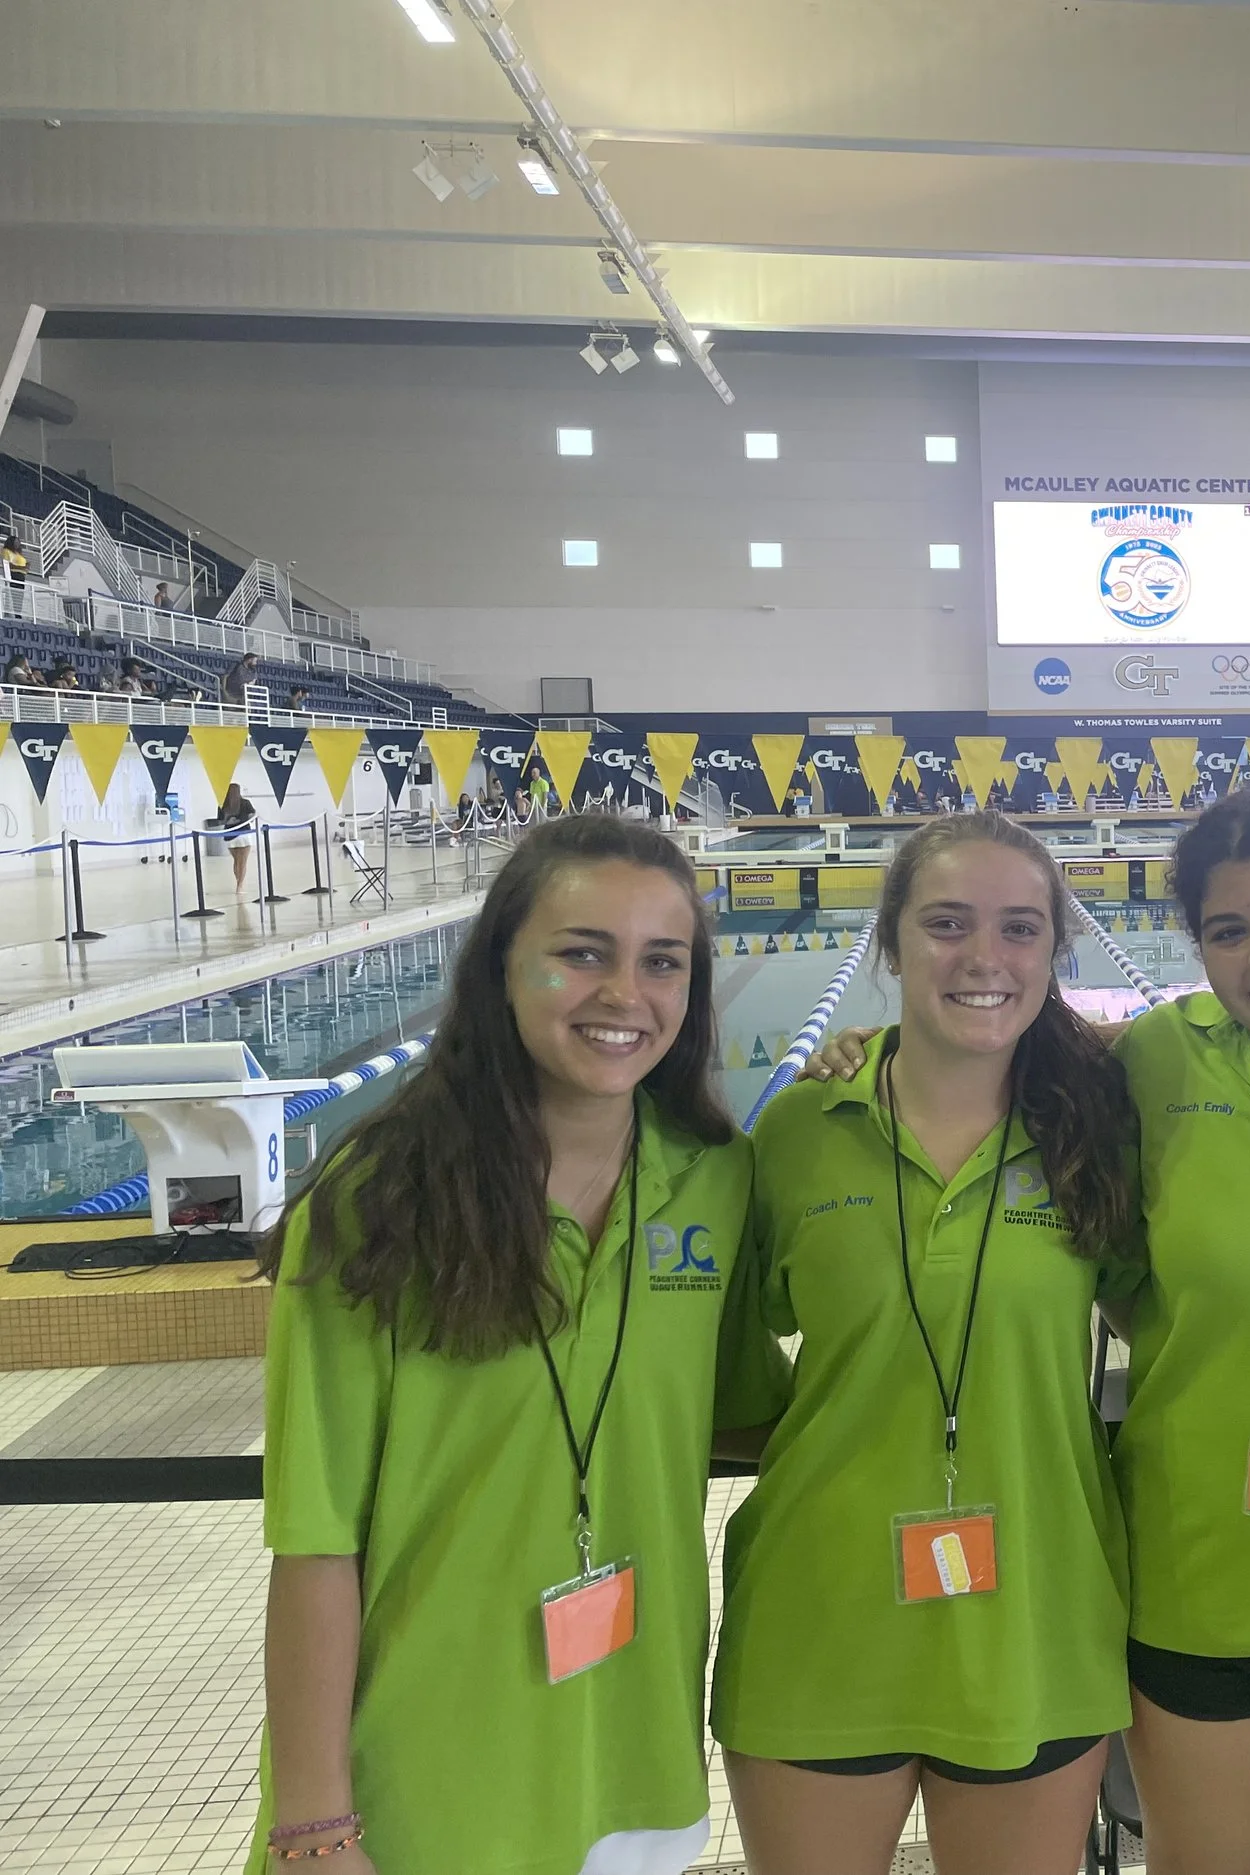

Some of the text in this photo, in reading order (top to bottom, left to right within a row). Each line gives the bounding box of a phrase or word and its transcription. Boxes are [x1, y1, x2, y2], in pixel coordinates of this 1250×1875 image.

[1004, 477, 1100, 492] MCAULEY
[1104, 478, 1191, 493] AQUATIC
[1149, 505, 1193, 528] COUNTY
[1038, 675, 1071, 686] NCAA
[1114, 654, 1180, 697] GT
[1198, 718, 1222, 726] SUITE
[21, 738, 58, 762] GT
[141, 739, 178, 763] GT
[260, 743, 297, 766] GT
[375, 744, 413, 767] GT
[489, 746, 526, 768] GT
[602, 748, 637, 770] GT
[708, 750, 742, 771] GT
[812, 750, 845, 771] GT
[914, 750, 946, 771] GT
[363, 760, 373, 772] 6
[1015, 751, 1046, 772] GT
[1111, 751, 1142, 772] GT
[1206, 752, 1236, 773] GT
[1166, 1102, 1235, 1115] Coach Emily
[268, 1132, 279, 1183] 8
[805, 1195, 874, 1218] Coach Amy
[1004, 1209, 1053, 1221] PEACHTREE
[649, 1275, 688, 1283] PEACHTREE
[650, 1283, 722, 1292] WAVERUNNERS
